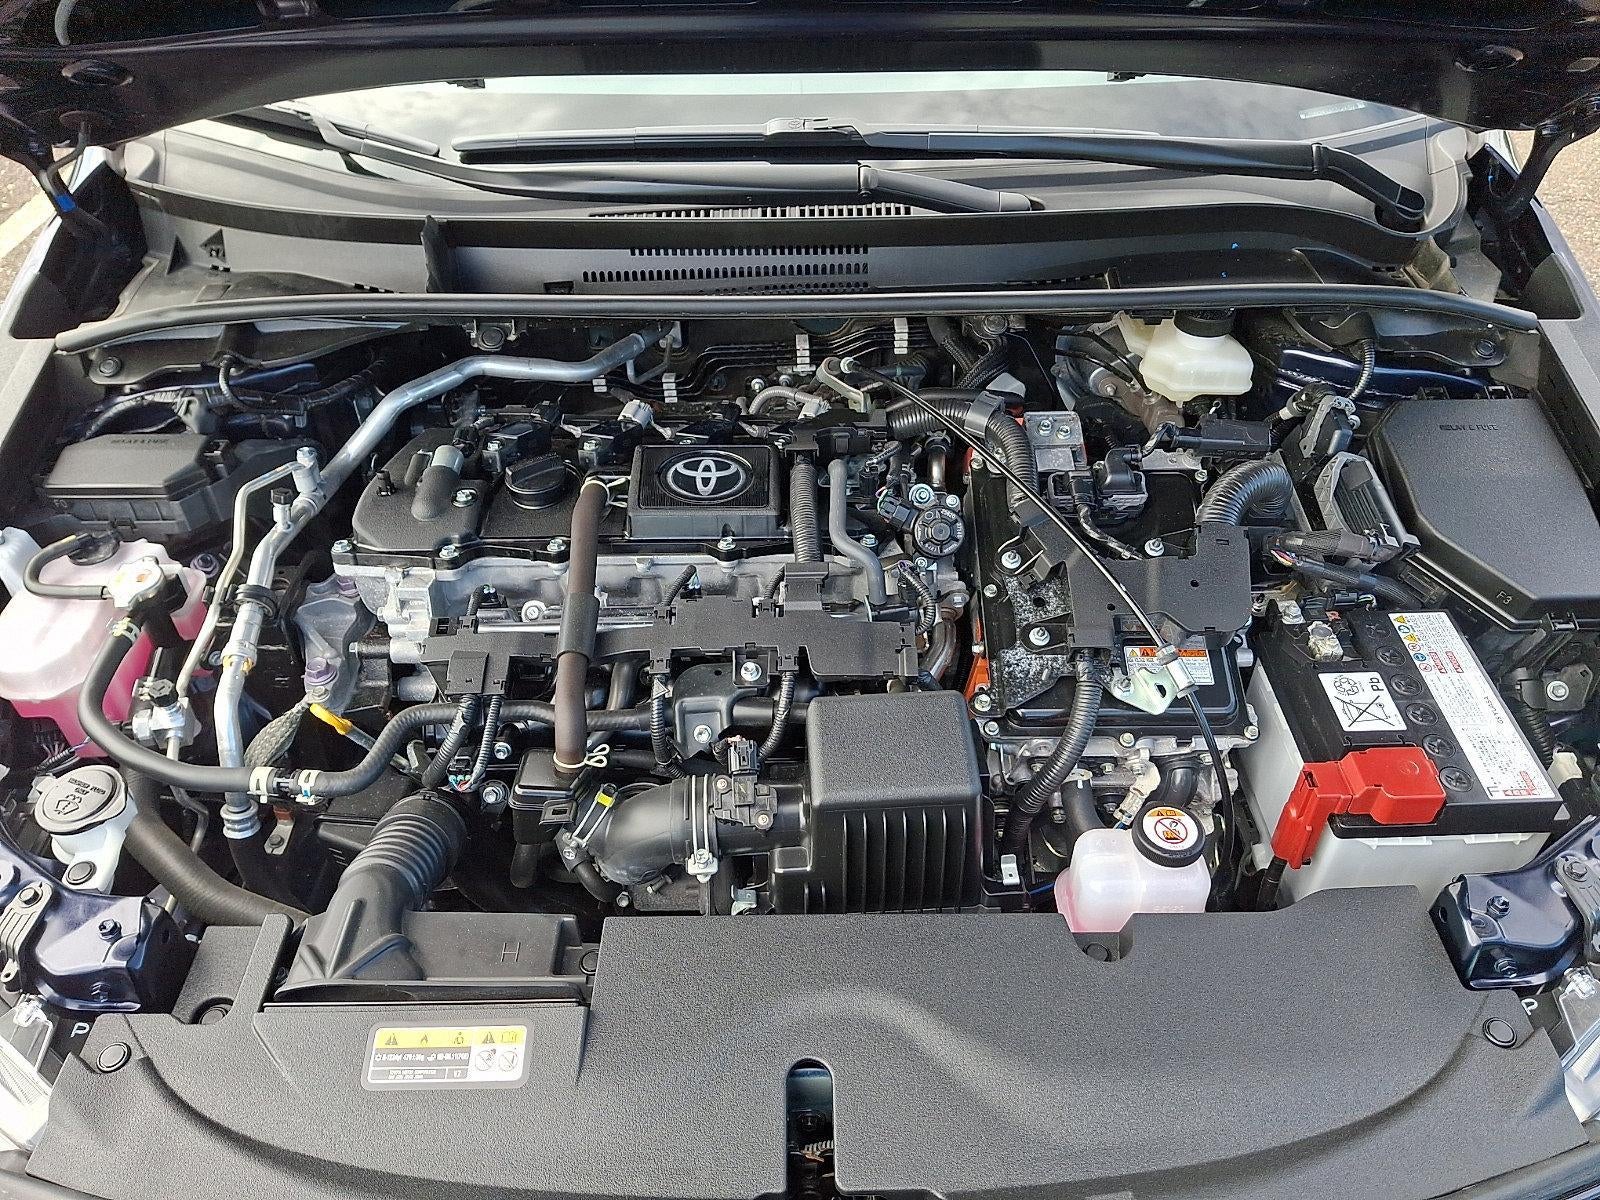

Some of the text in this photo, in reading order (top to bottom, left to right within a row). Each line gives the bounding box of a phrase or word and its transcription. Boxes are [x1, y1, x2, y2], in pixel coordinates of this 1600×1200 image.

[1495, 590, 1513, 605] F3
[1369, 677, 1384, 692] Pb
[500, 942, 521, 962] H
[1521, 998, 1538, 1016] P
[70, 1022, 90, 1038] P
